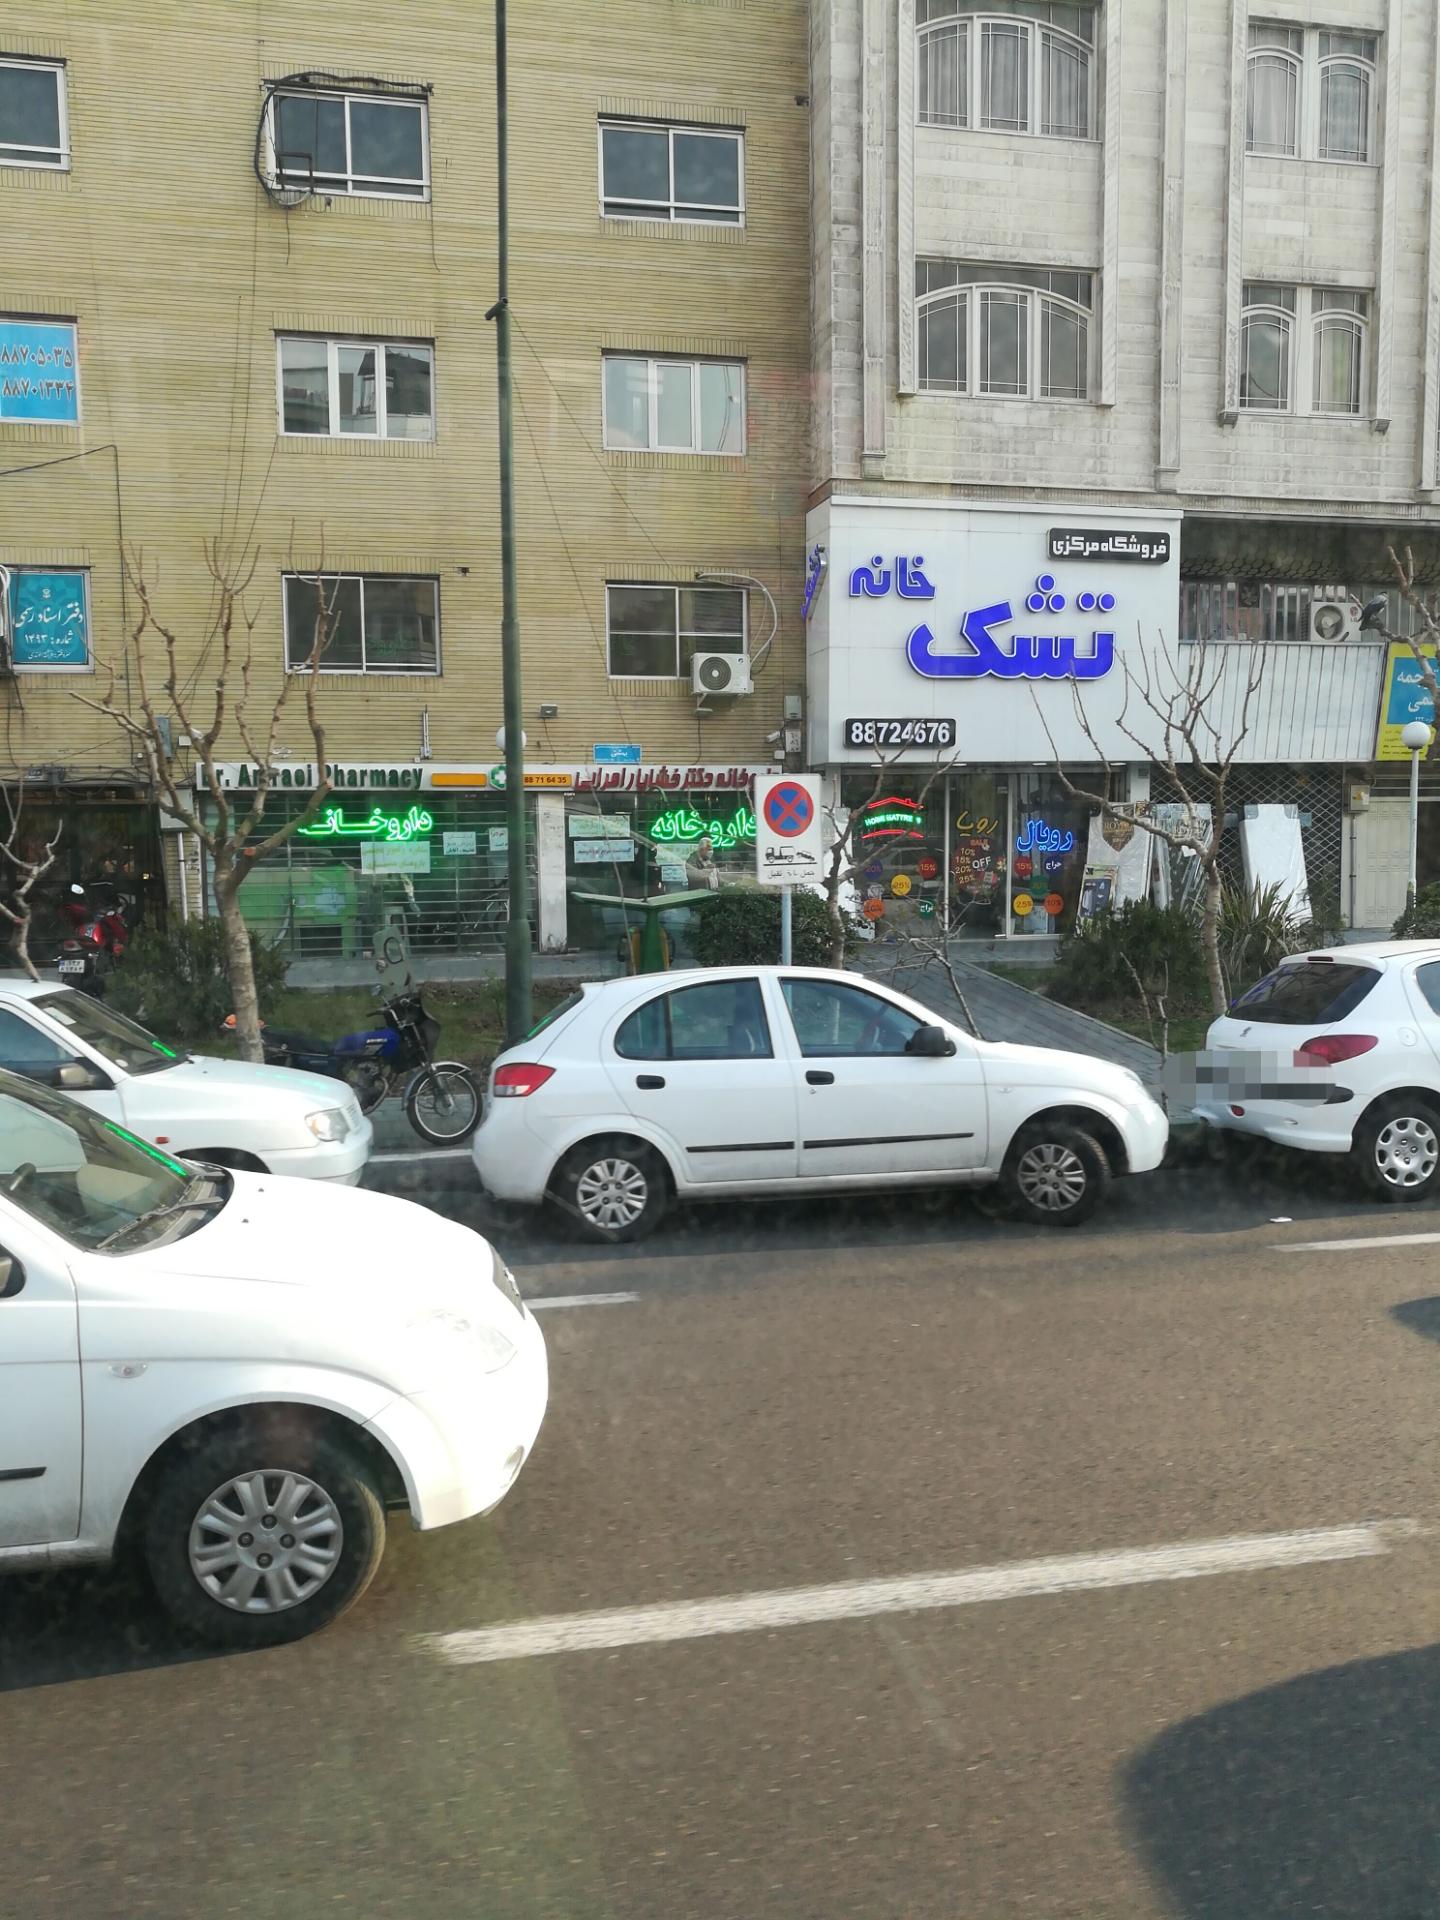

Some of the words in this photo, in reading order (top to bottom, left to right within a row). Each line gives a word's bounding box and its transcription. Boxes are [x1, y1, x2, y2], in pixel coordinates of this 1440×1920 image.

[1052, 535, 1100, 556] مرکزی
[1100, 534, 1167, 558] فروشگاه
[850, 555, 936, 600] خانه
[61, 601, 83, 626] دفتر
[907, 573, 1117, 680] تشک
[850, 721, 951, 745] 88724676
[1016, 819, 1074, 852] رویال
[972, 856, 992, 869] OFF
[1045, 860, 1062, 871] حراج
